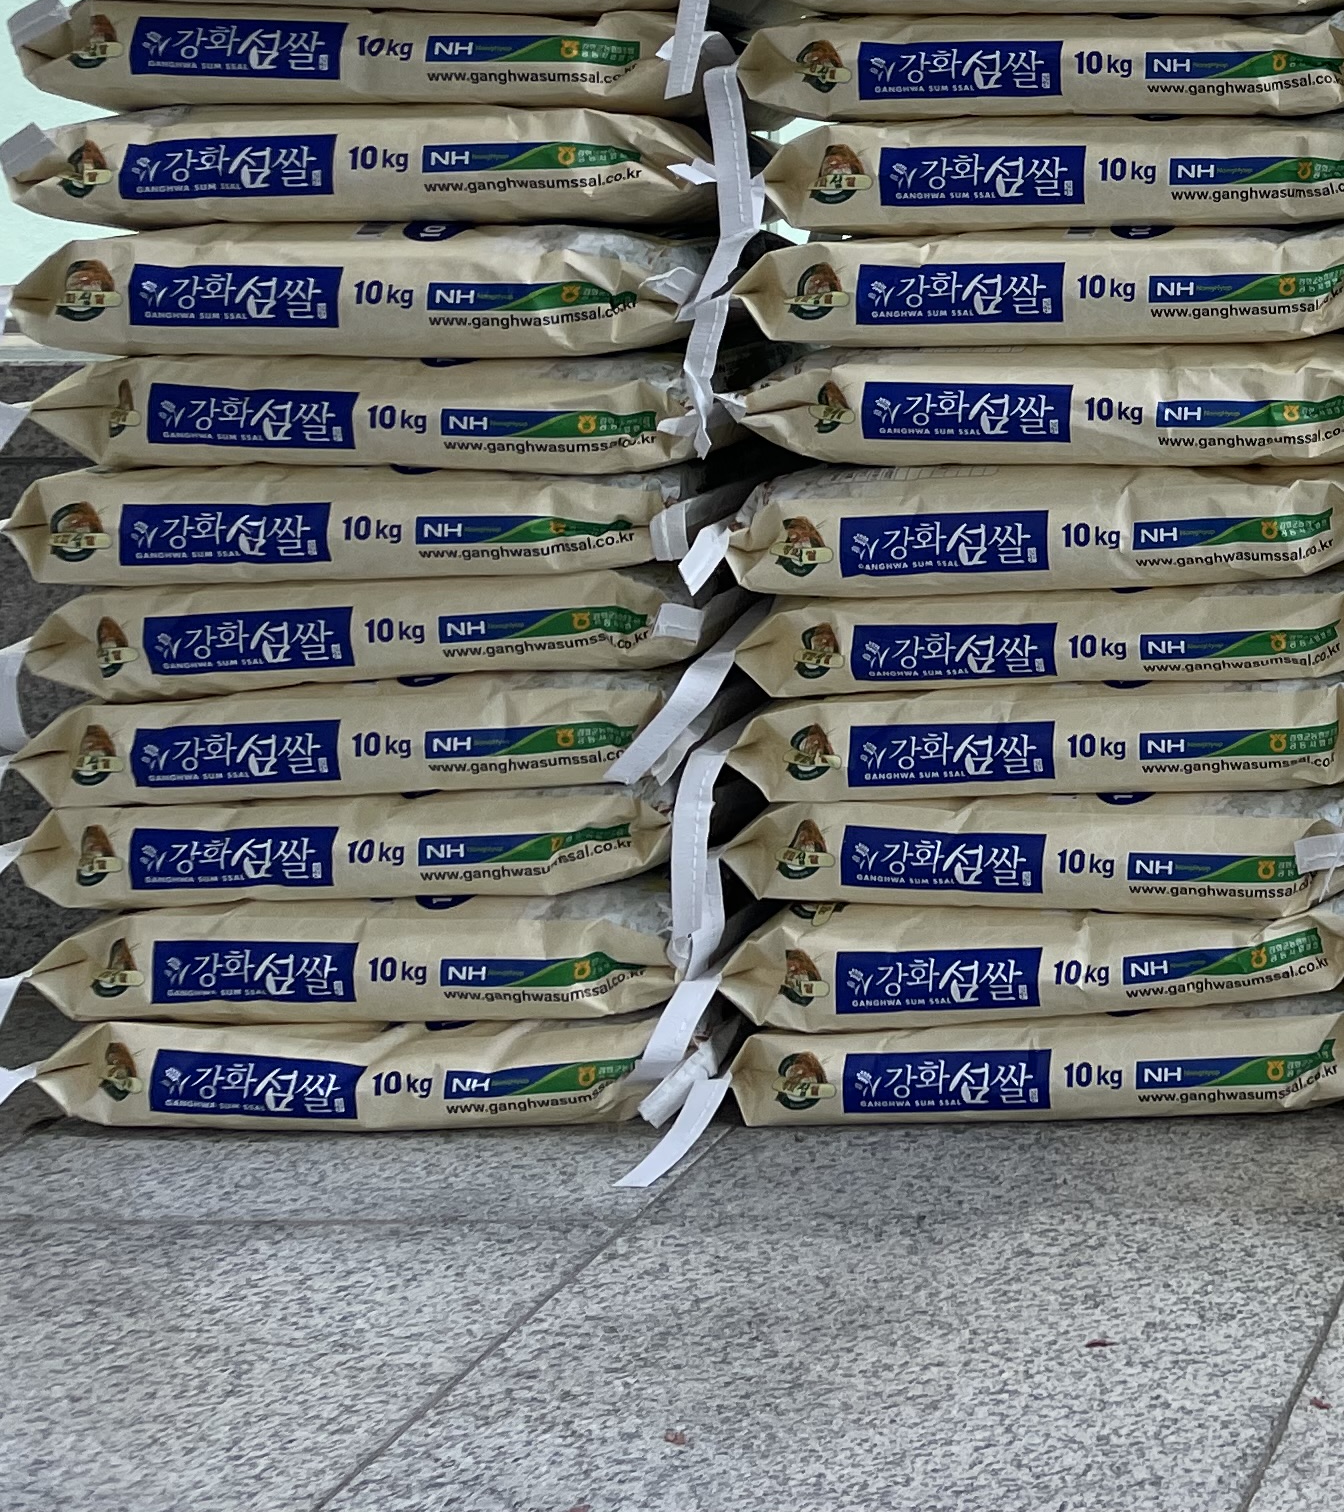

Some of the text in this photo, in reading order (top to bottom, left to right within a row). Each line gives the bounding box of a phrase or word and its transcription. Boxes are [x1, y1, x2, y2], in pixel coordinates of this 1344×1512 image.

[136, 185, 190, 193] GANGHWA
[194, 183, 216, 191] SUM
[164, 145, 321, 188] 강화섬쌀
[430, 150, 470, 166] NH
[424, 167, 642, 195] www.ganghwasumssal.co.kr
[919, 153, 1071, 197] 강화섬쌀
[1177, 164, 1215, 179] NH
[896, 191, 946, 199] GANGHWA
[950, 191, 970, 199] SUM
[160, 512, 315, 556] 강화섬쌀
[423, 523, 463, 538] NH
[882, 521, 1033, 565] 강화섬쌀
[1140, 526, 1178, 543] NH
[1135, 538, 1333, 569] www.ganghwasumssal.co.kr
[891, 632, 1041, 673] 강화섬쌀
[1147, 640, 1185, 655] NH
[191, 950, 342, 995] 강화섬쌀
[447, 966, 487, 981] NH
[875, 958, 1026, 1002] 강화섬쌀
[1130, 959, 1169, 978] NH
[1125, 953, 1328, 998] www.ganghwasumssal.co.kr
[884, 1060, 1036, 1103] 강화섬쌀
[1143, 1066, 1182, 1083] NH
